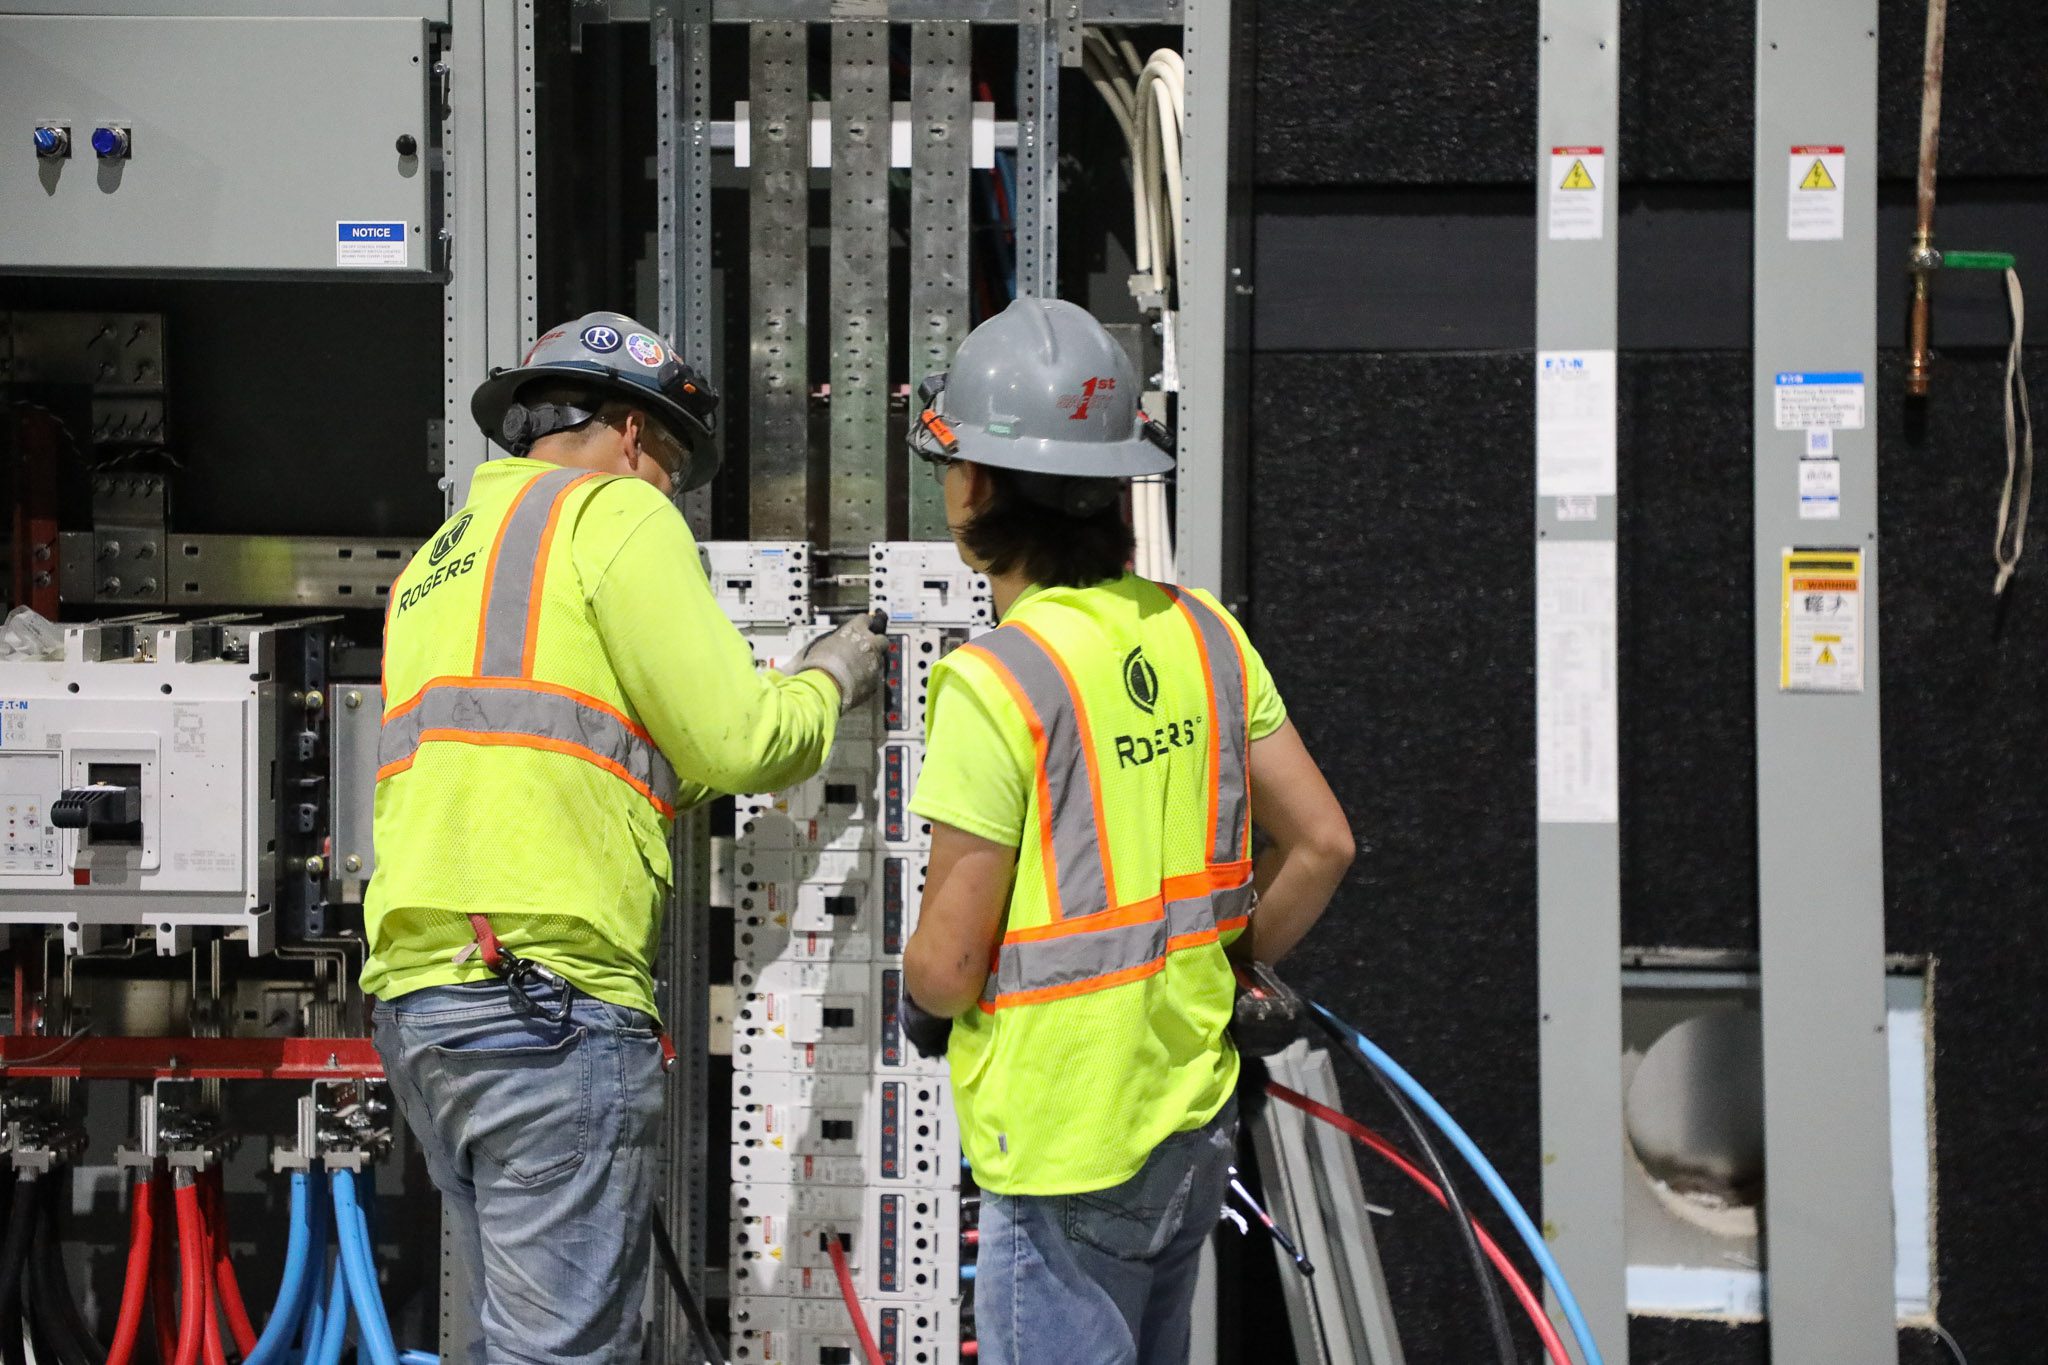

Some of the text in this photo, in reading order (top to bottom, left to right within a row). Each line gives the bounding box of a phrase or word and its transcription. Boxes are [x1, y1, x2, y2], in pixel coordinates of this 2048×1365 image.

[352, 227, 391, 237] NOTICE
[1068, 376, 1116, 420] 1st
[397, 551, 476, 618] ROGERS
[1115, 719, 1195, 769] ROERS
